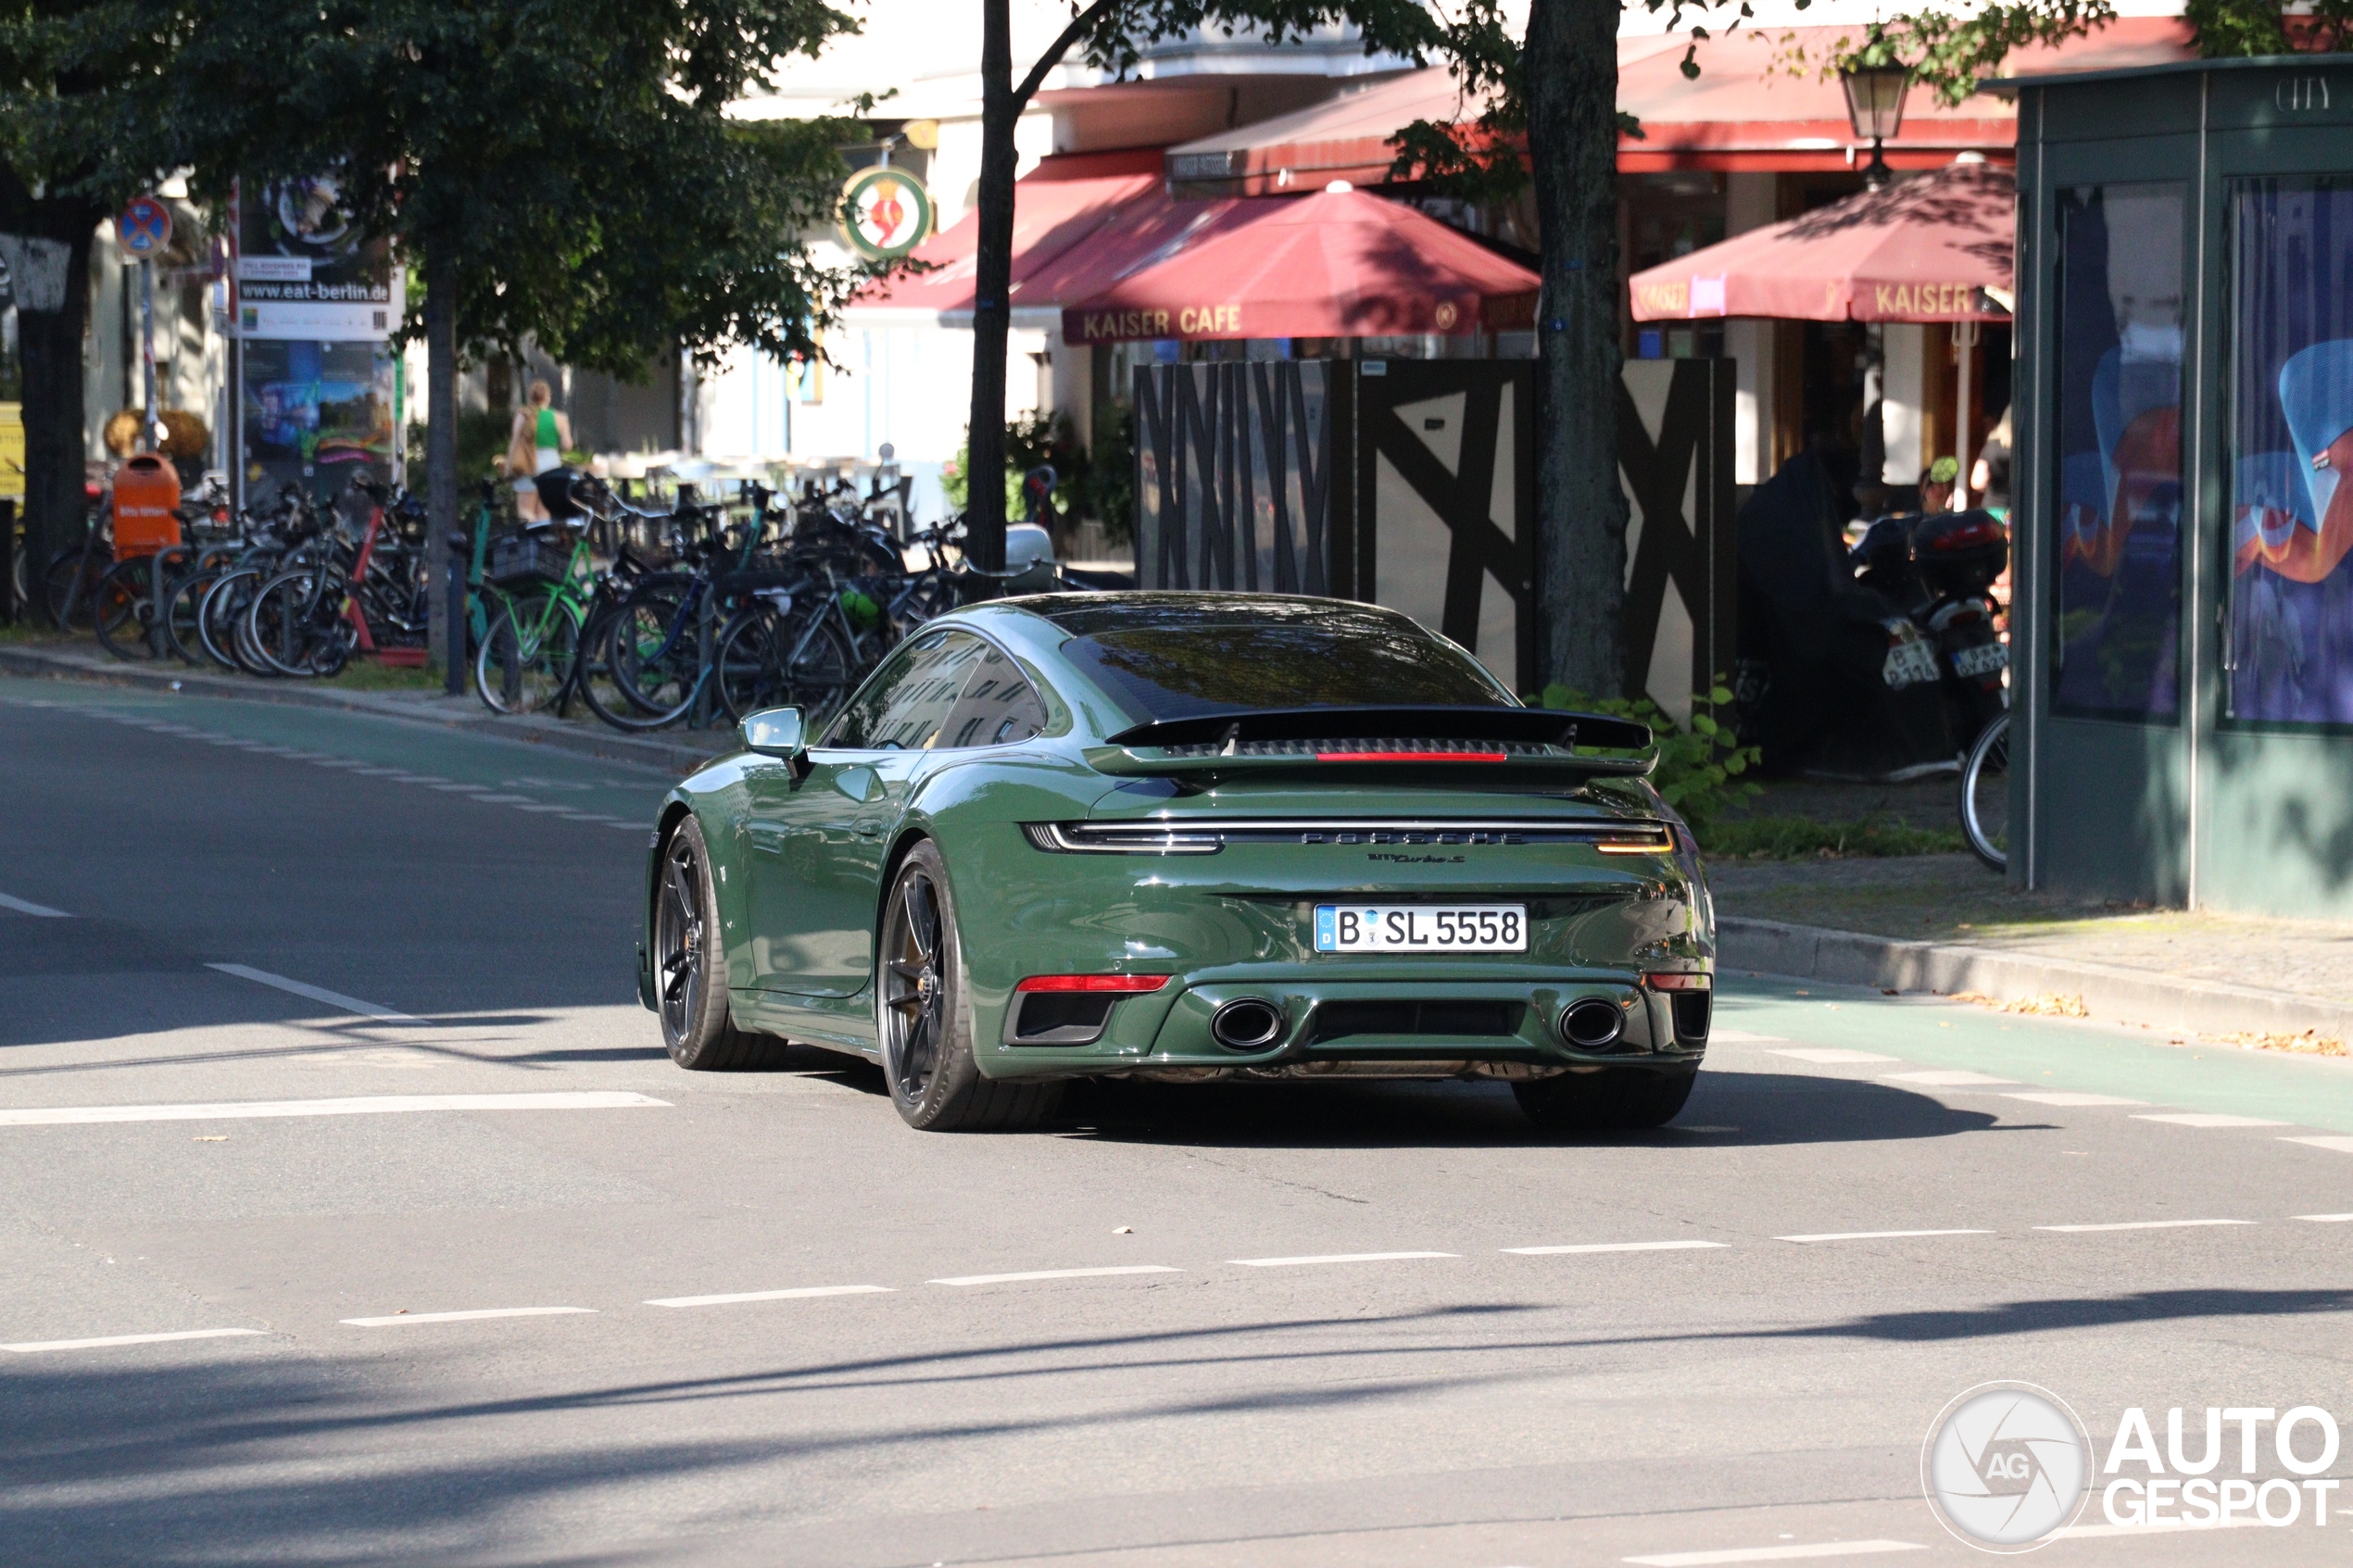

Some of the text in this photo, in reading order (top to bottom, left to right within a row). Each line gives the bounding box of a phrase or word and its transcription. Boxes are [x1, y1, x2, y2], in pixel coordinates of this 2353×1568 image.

[243, 281, 388, 301] www.eat-berlin.de
[1874, 282, 1971, 314] KAISER
[1083, 305, 1241, 340] KAISER CAFE
[1301, 832, 1523, 845] PORSCHE
[1322, 933, 1331, 945] D
[1340, 911, 1520, 945] B SL 5558
